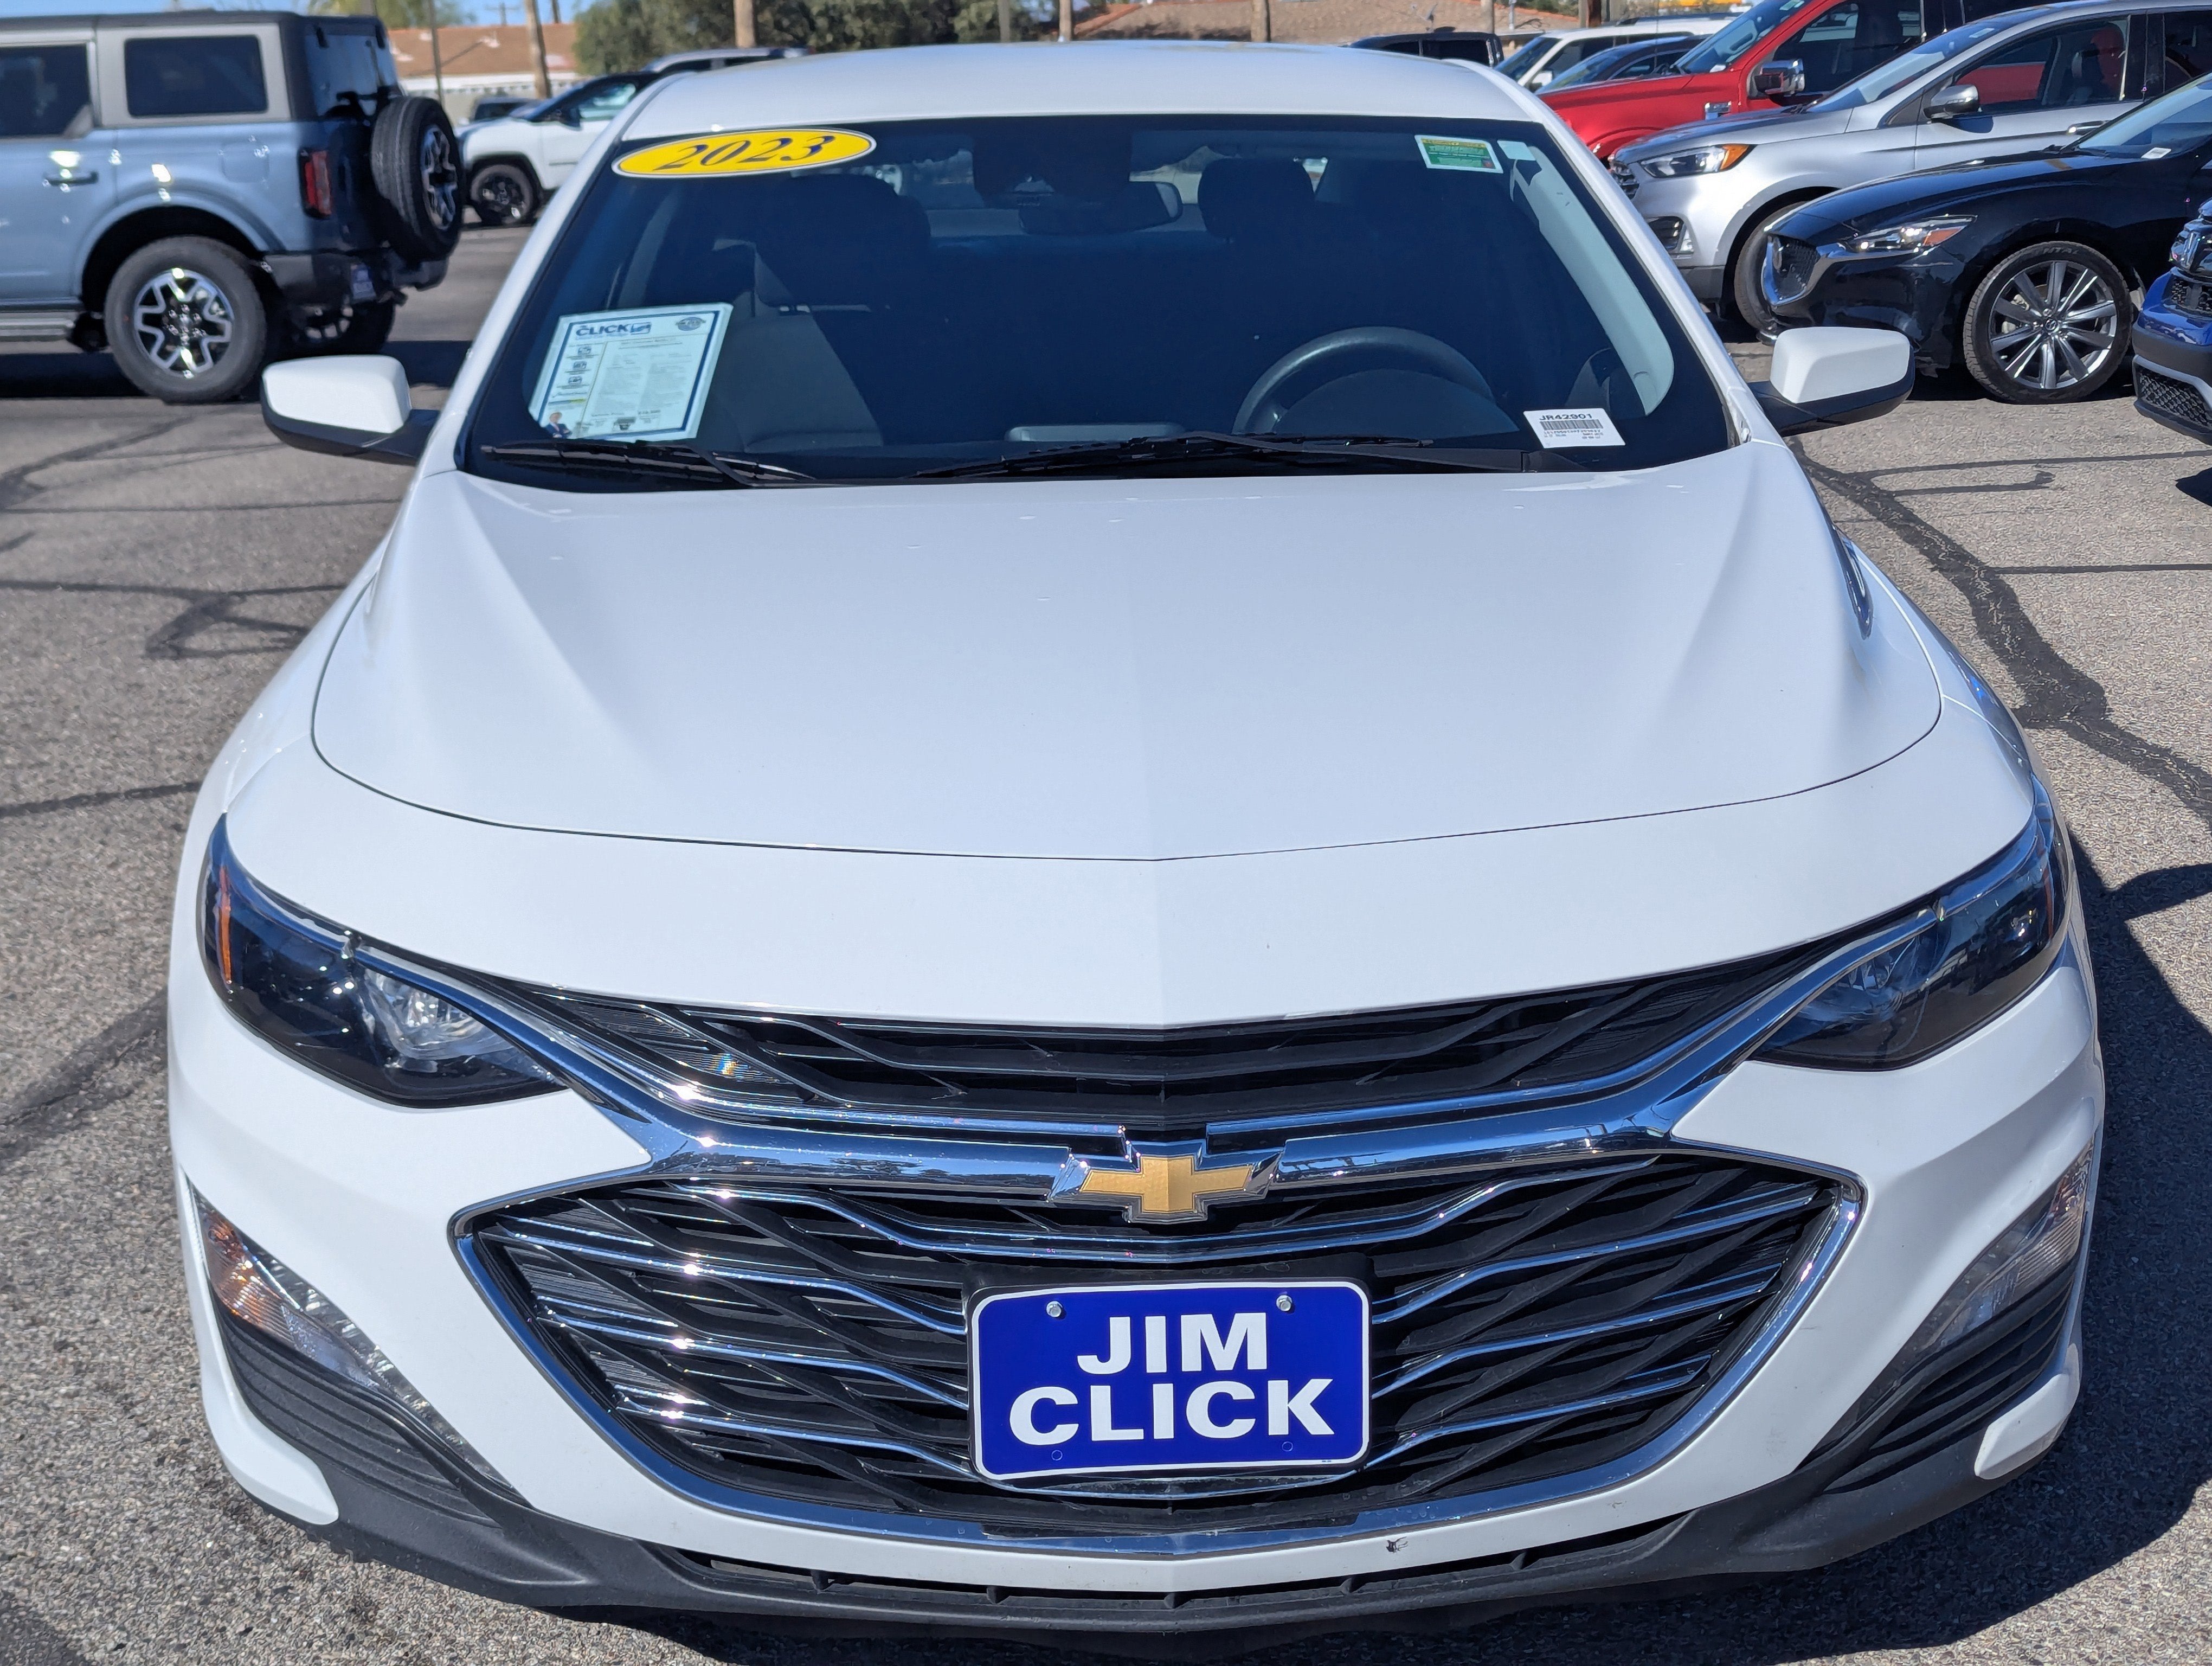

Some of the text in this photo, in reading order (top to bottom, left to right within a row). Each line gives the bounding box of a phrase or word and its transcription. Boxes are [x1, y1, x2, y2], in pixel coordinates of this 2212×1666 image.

[652, 135, 835, 171] 2023
[576, 324, 629, 336] CLICK
[1077, 1312, 1268, 1374] JIM
[1009, 1379, 1335, 1445] CLICK
